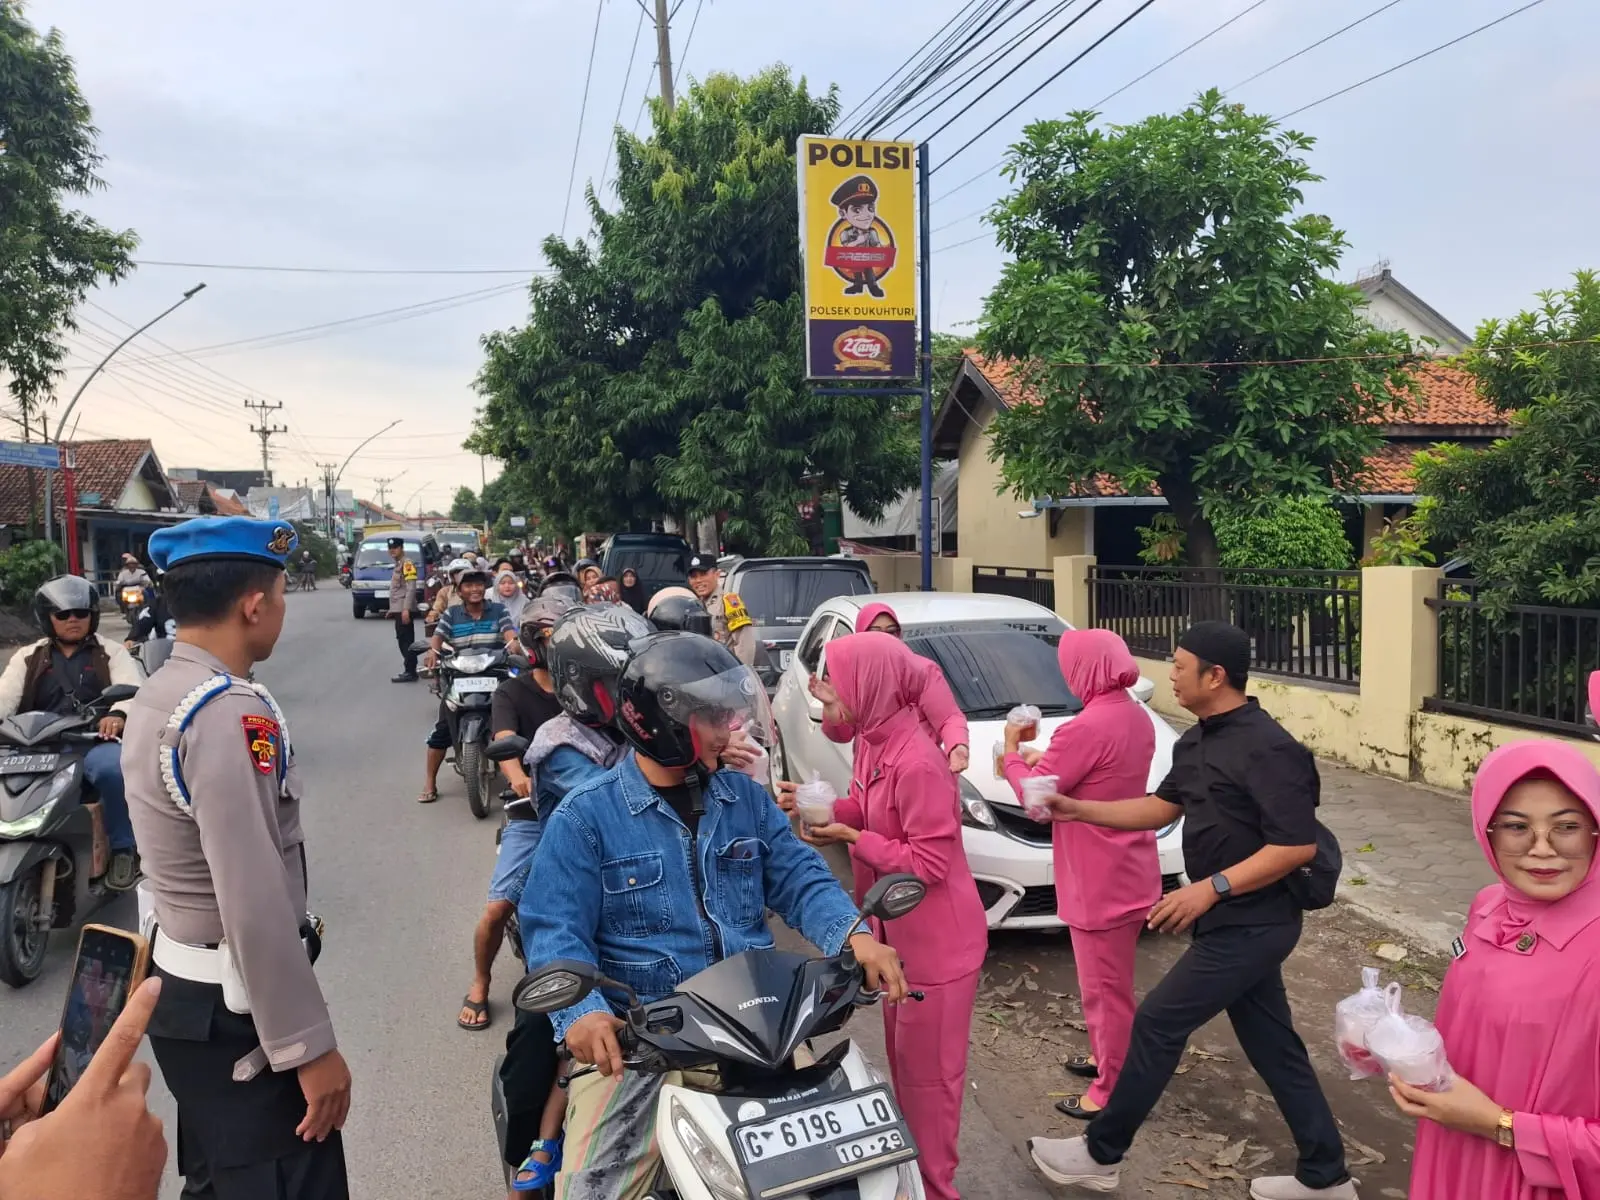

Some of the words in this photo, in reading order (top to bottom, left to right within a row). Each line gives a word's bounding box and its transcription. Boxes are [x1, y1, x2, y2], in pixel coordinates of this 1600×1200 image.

[808, 143, 910, 169] POLISI
[810, 306, 851, 316] POLSEK
[853, 306, 914, 316] DUKUHTURI
[247, 717, 274, 728] PROPAM
[738, 995, 779, 1010] HONDA
[745, 1131, 763, 1157] G
[780, 1110, 842, 1147] 6196
